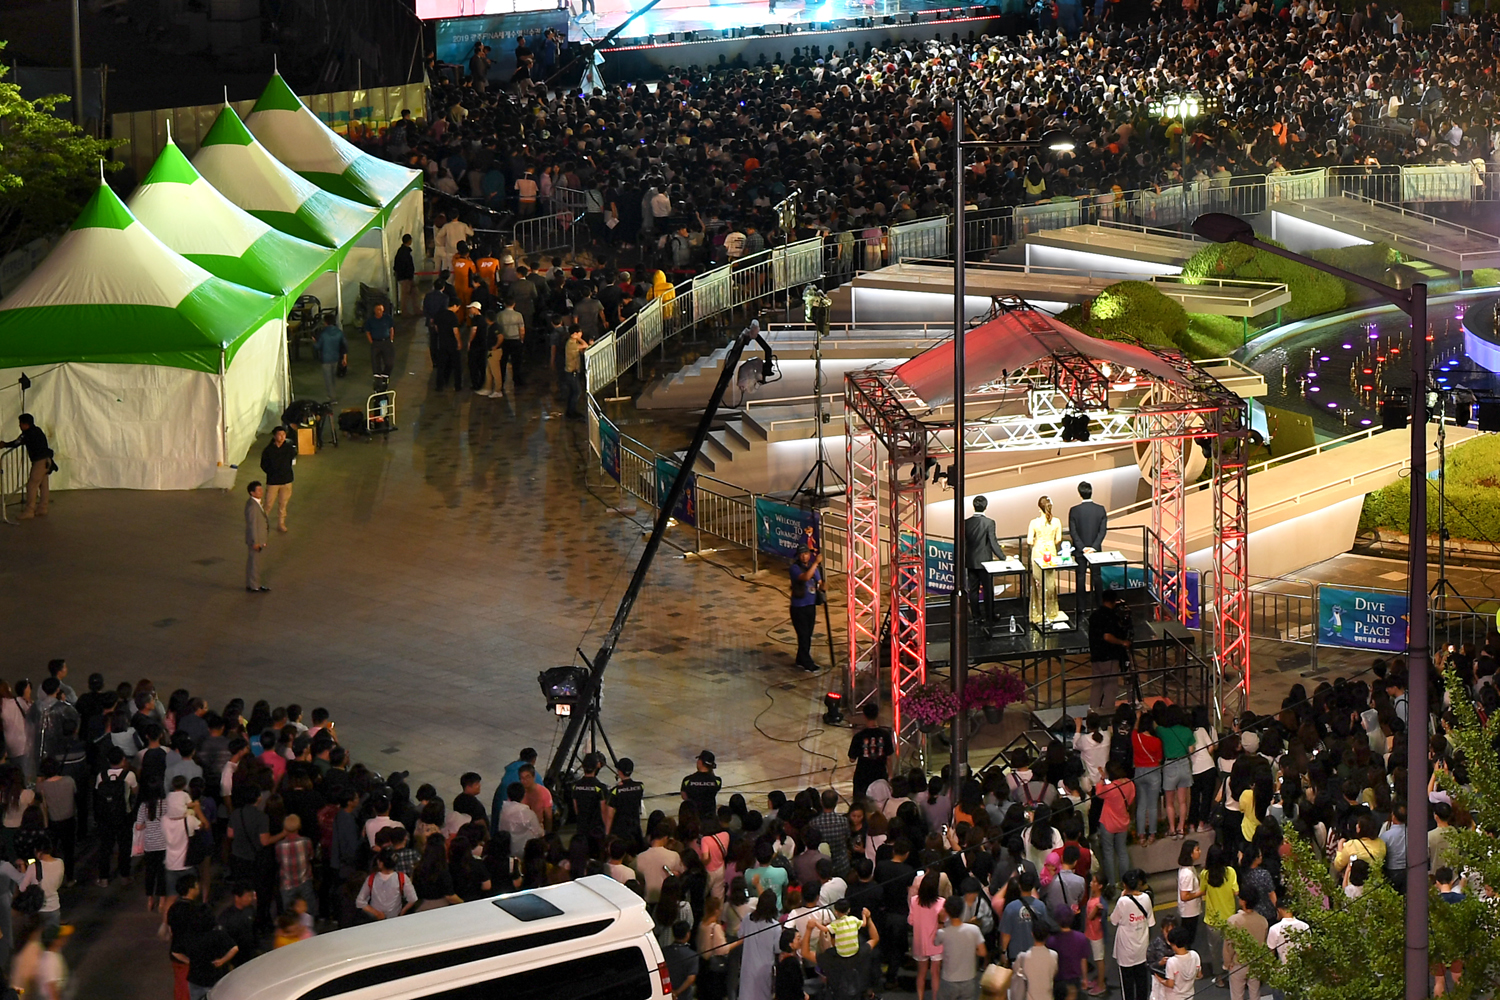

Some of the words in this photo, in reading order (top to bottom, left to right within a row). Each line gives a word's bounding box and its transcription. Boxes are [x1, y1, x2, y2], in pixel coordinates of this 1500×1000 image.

[452, 33, 469, 43] 2019
[775, 513, 801, 527] WELCOME
[794, 526, 803, 535] TO
[928, 545, 953, 561] DIVE
[938, 561, 955, 572] INT
[928, 567, 955, 583] PEAC
[1354, 597, 1386, 613] DIVE
[1366, 613, 1396, 625] INTO
[1354, 621, 1391, 637] PEACE
[617, 785, 642, 793] POLICE
